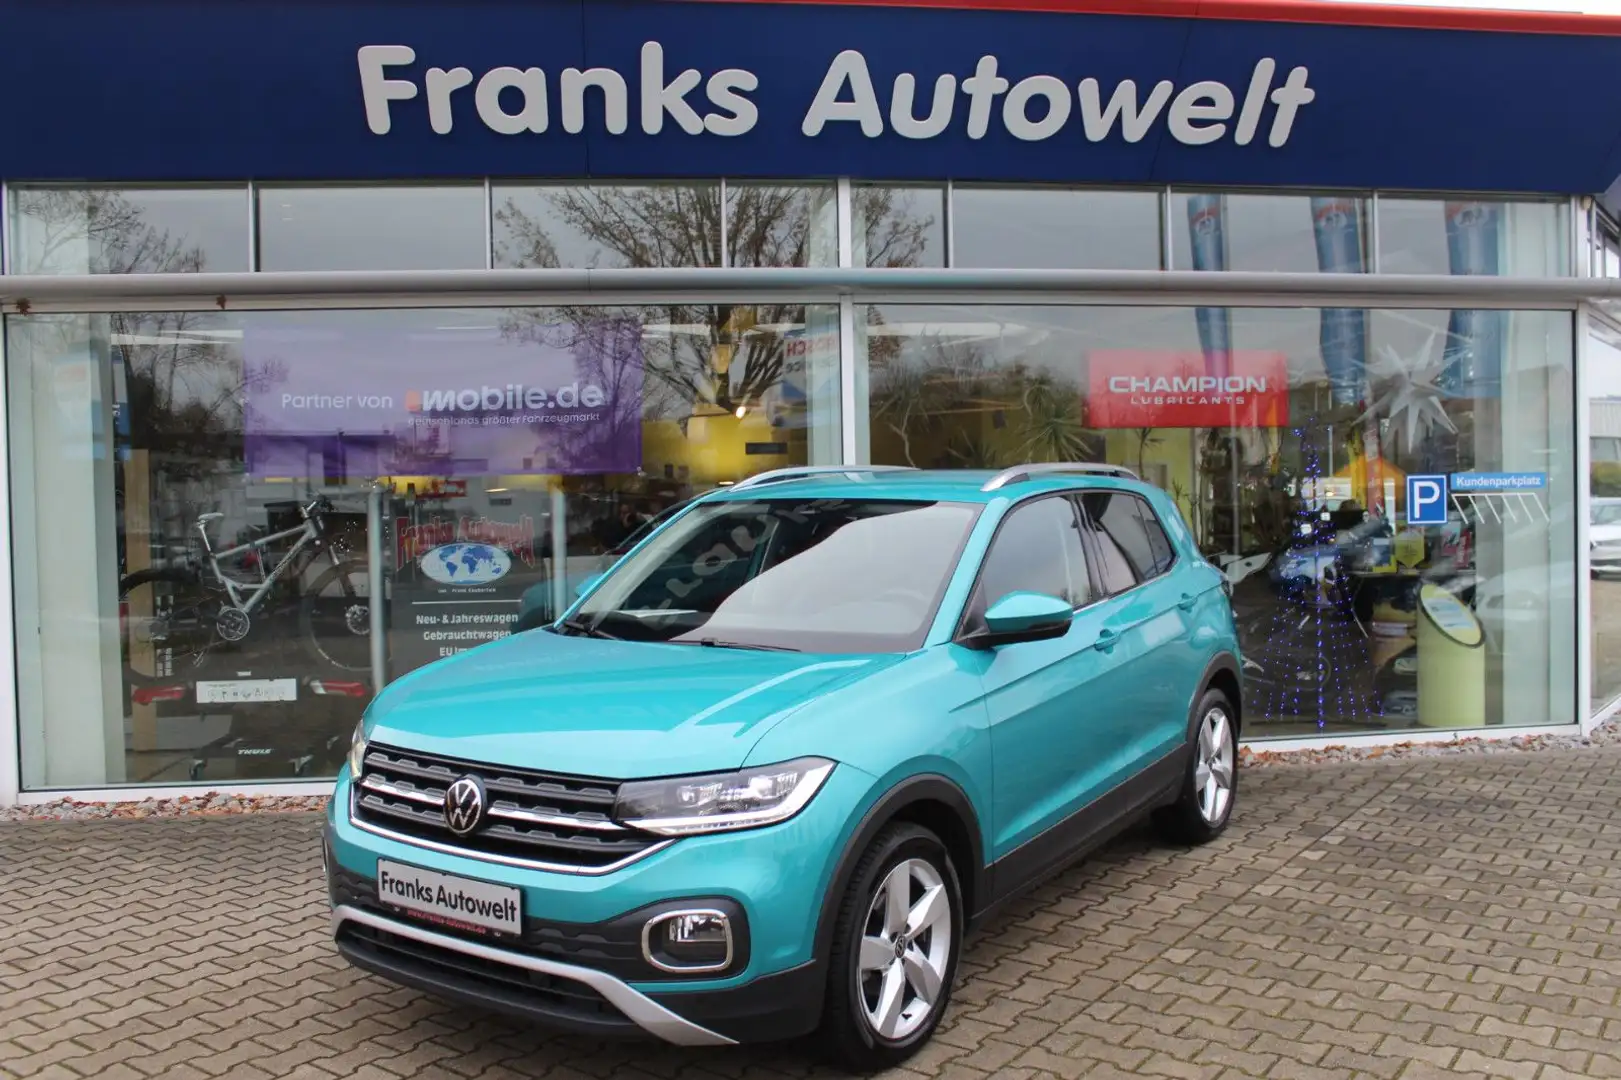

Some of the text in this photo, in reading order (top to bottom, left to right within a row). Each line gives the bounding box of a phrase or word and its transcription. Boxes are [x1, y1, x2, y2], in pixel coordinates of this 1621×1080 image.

[357, 40, 1315, 148] Franks Autowelt
[1108, 376, 1267, 393] CHAMPION
[281, 393, 394, 409] Partner von
[421, 383, 604, 412] mobile.de
[1130, 396, 1245, 405] LUBRICANTS
[482, 415, 520, 426] größter
[522, 412, 601, 424] Fahrzeugmarkt
[1456, 476, 1541, 488] Kundenparkplatz
[1413, 481, 1440, 519] P
[416, 613, 518, 626] Neu- & Jahreswagen
[423, 629, 512, 641] Gebrauchtwagen
[439, 647, 452, 657] EU
[381, 871, 517, 922] Franks Autowelt
